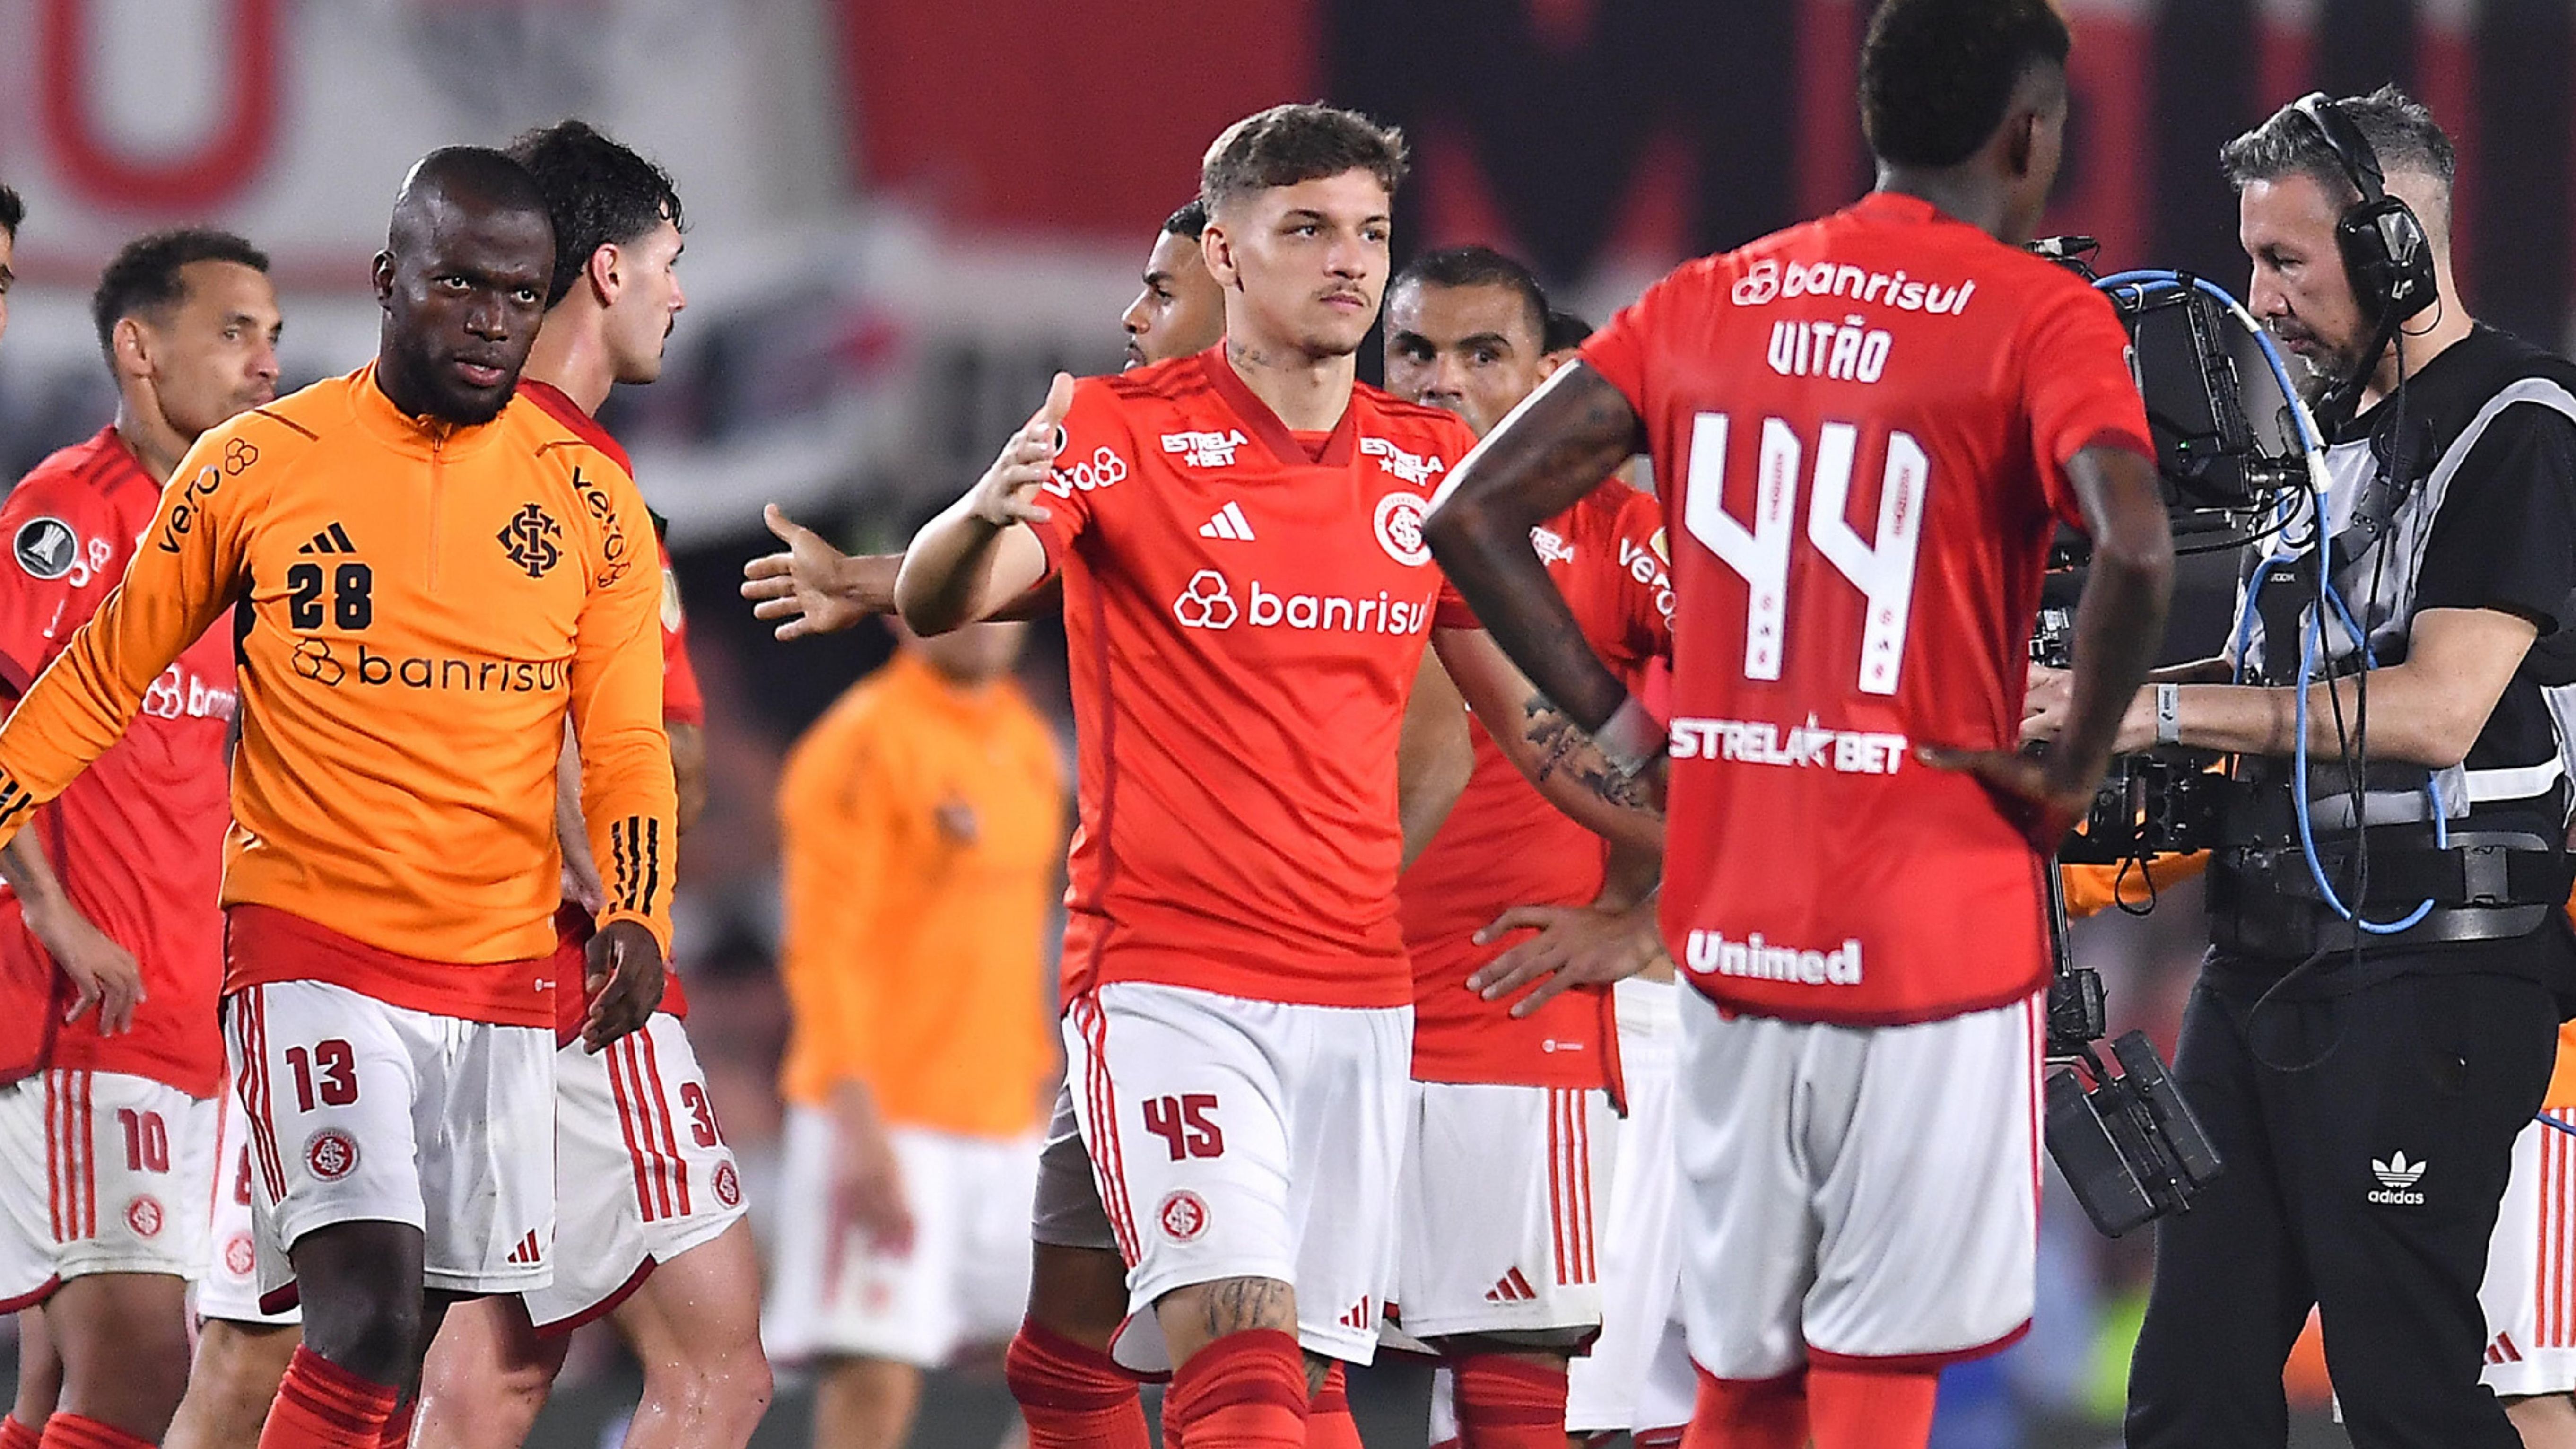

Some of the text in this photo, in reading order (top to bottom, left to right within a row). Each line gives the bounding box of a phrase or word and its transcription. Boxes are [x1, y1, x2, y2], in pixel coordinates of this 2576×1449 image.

[1781, 261, 1976, 315] banrisul
[1767, 314, 1893, 384] VITÃO
[1161, 429, 1249, 453] ESTRELA
[1197, 447, 1235, 467] BET
[1360, 437, 1445, 473] ESTRELA
[1042, 462, 1096, 499] vo
[1393, 461, 1429, 487] BET
[159, 465, 220, 553] vero
[1529, 526, 1574, 565] TRELA
[1684, 411, 1931, 696] 44
[287, 563, 372, 630] 28
[1249, 580, 1432, 635] banrisul
[358, 645, 566, 691] banrisul
[1668, 718, 1908, 775] STRELA BET
[1686, 928, 1863, 985] Unimed
[286, 1039, 359, 1113] 13
[118, 1108, 170, 1173] 10
[680, 1081, 725, 1148] 3
[1142, 1092, 1225, 1161] 45
[2368, 1190, 2424, 1204] adidas
